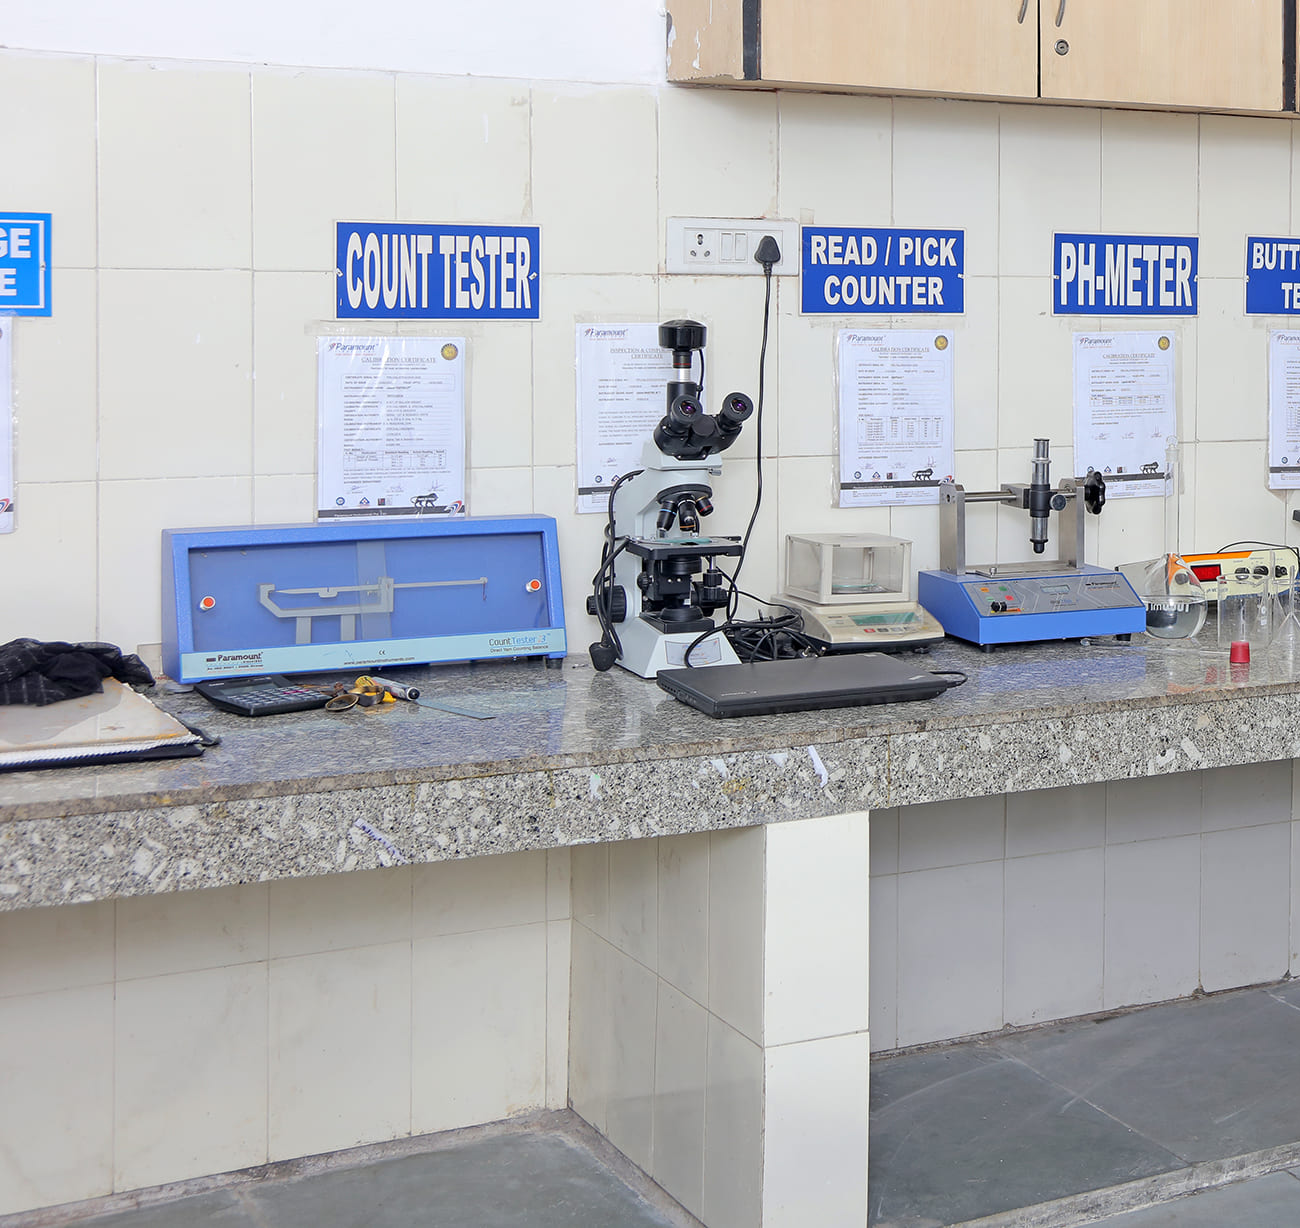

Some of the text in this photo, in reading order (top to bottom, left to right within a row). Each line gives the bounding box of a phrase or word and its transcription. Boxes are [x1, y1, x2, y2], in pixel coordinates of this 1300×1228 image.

[810, 235, 957, 267] READ / PICK
[346, 231, 531, 310] COUNT TESTER
[1060, 242, 1193, 307] PH-METER
[824, 275, 944, 305] COUNTER
[335, 342, 377, 351] Paramount
[852, 334, 884, 342] Paramount
[218, 653, 261, 661] Paramount
